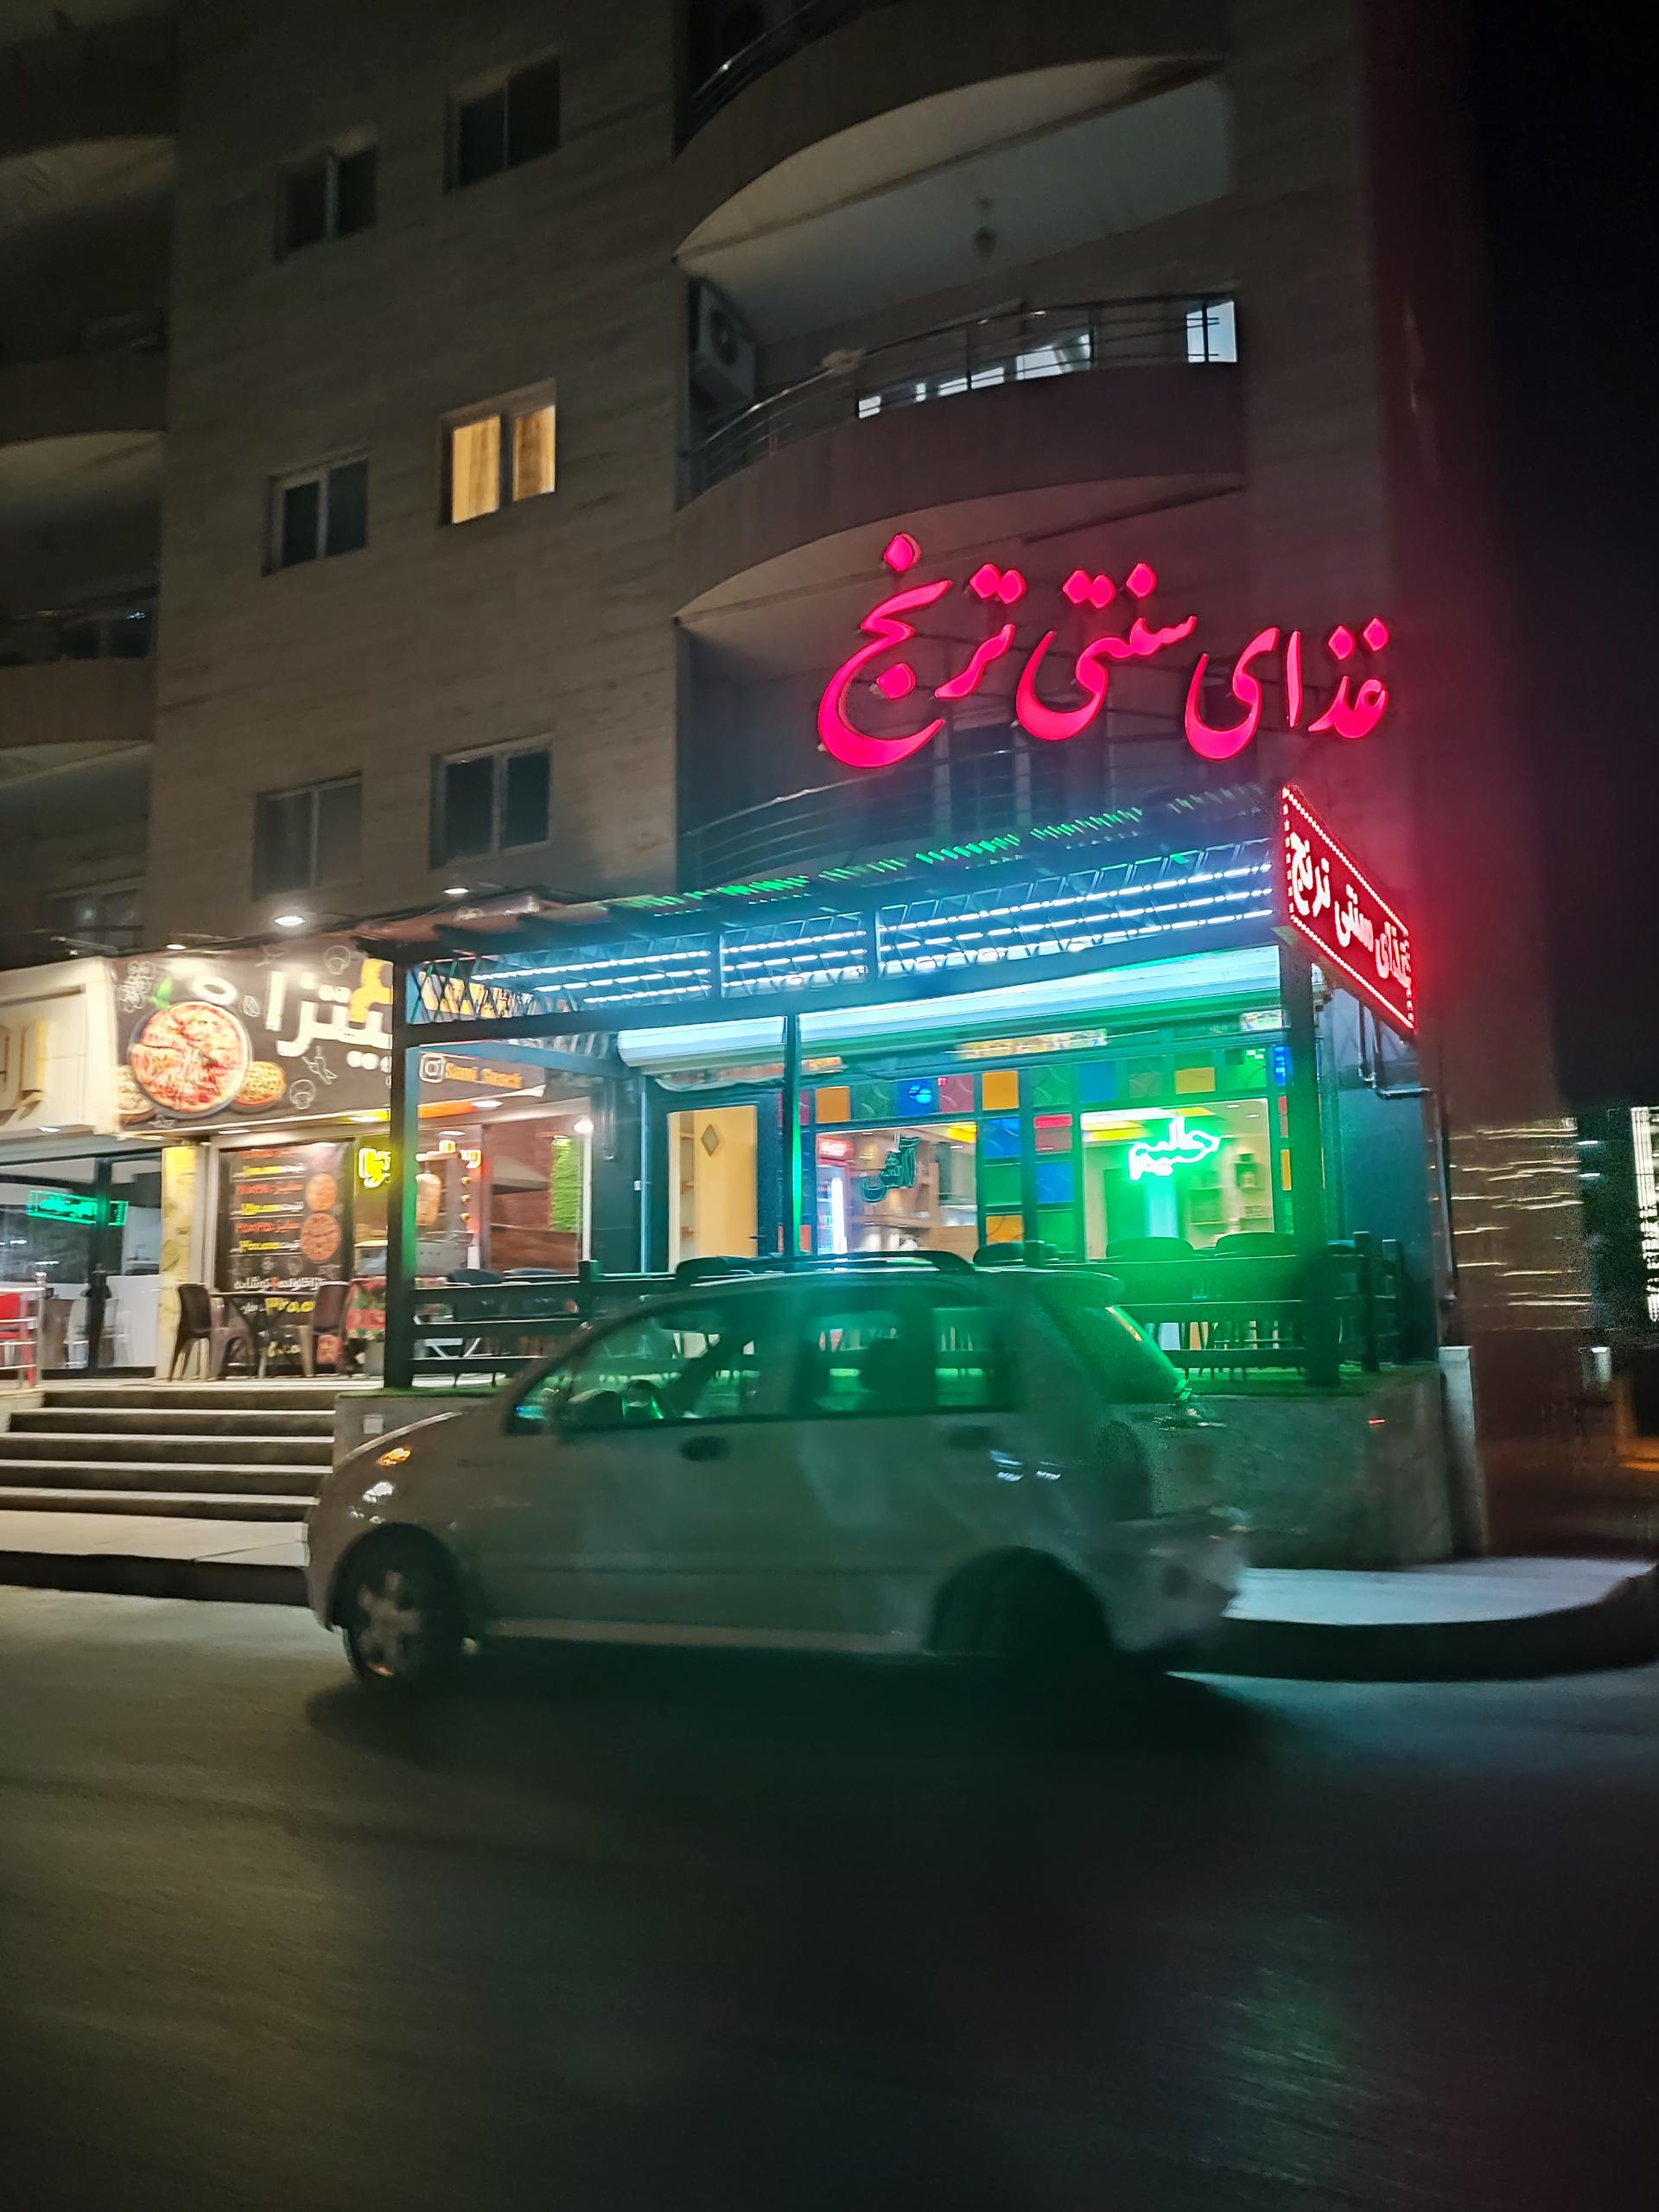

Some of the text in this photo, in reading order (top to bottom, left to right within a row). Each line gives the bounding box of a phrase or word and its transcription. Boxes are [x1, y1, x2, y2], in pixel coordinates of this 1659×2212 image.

[818, 533, 1389, 767] غذای سنتی ترنج
[1290, 831, 1412, 990] غذای سنتی ترنج
